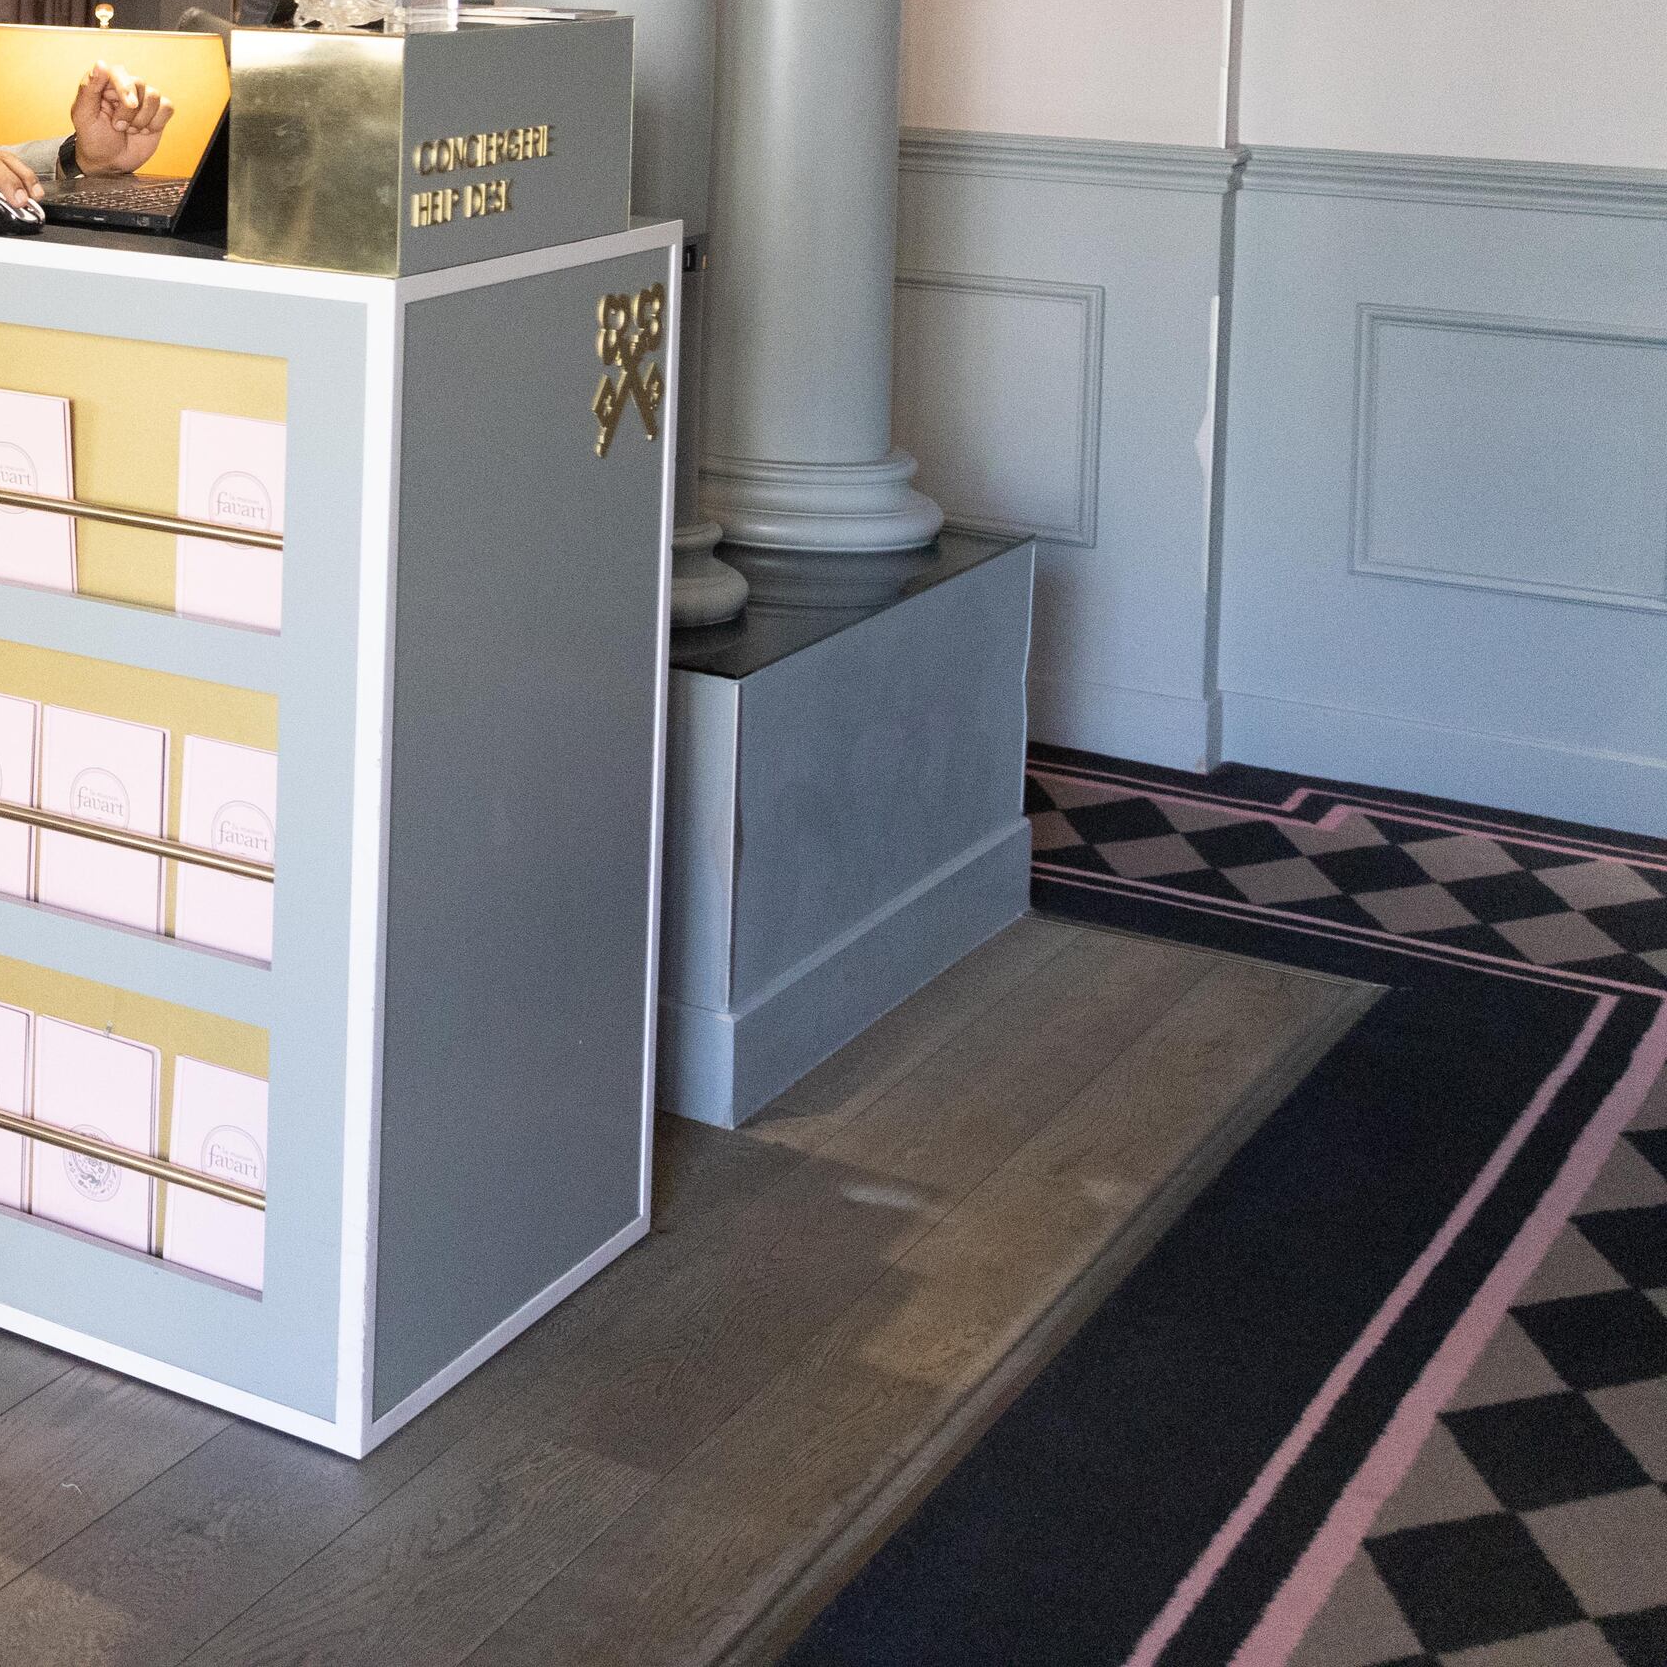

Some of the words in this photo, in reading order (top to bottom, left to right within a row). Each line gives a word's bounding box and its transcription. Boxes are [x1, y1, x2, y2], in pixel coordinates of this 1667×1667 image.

[414, 125, 555, 176] CONCIERGERIE
[411, 188, 460, 227] HELP
[464, 180, 513, 218] DESK
[216, 491, 266, 519] favart
[77, 786, 124, 817] favart
[219, 820, 268, 852] favart
[208, 1144, 259, 1179] favart
